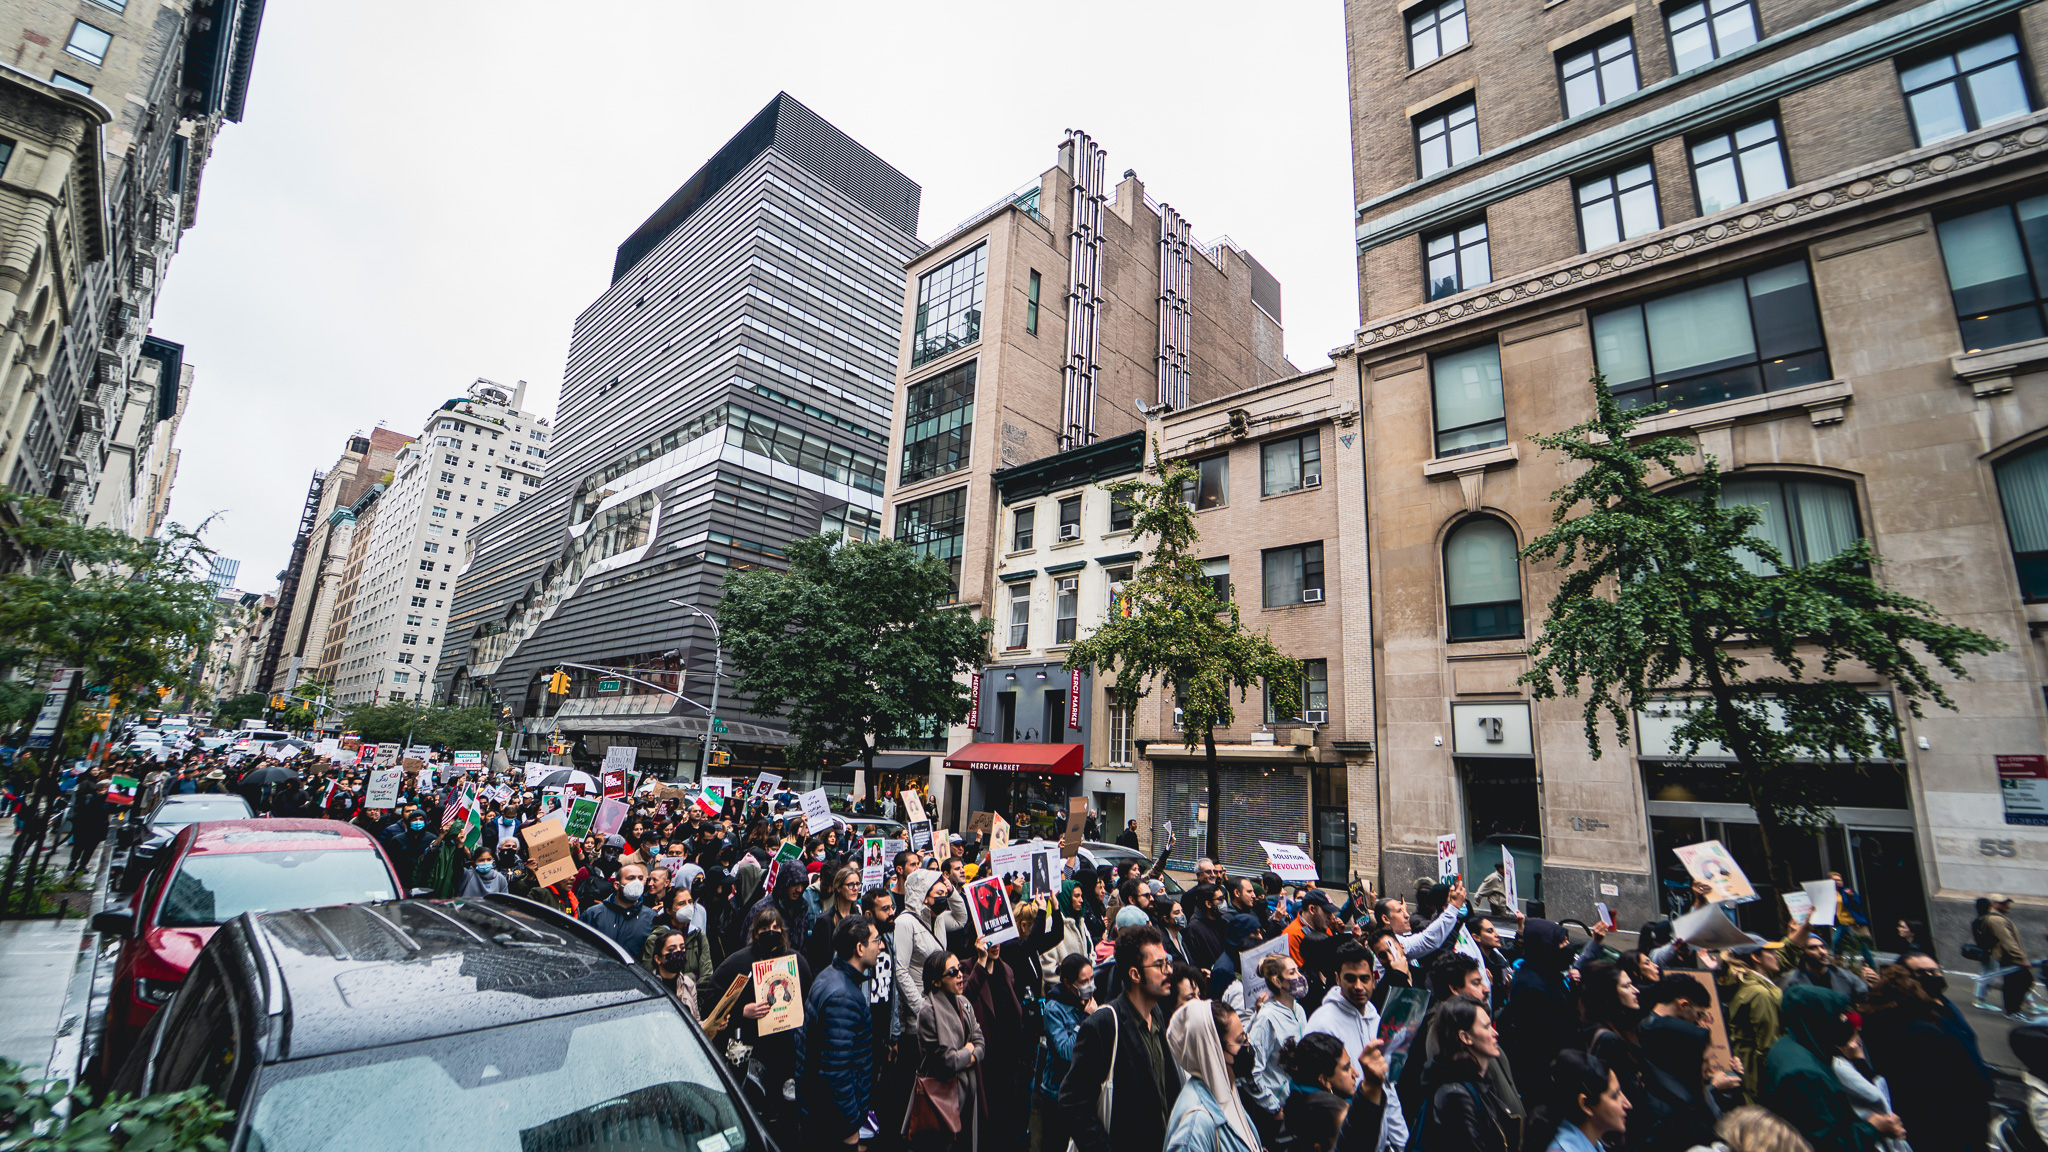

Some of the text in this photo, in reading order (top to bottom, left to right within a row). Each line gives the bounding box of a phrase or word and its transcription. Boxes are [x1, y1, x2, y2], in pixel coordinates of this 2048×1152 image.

[1071, 695, 1079, 727] MARKET
[970, 762, 1020, 771] MERCI MARKET
[1979, 838, 2017, 857] 55
[541, 867, 562, 880] IRAN
[1271, 863, 1315, 871] REVOLUTION
[1444, 859, 1452, 874] IS
[984, 920, 991, 931] BE
[989, 917, 1001, 929] THEIR
[999, 914, 1010, 925] VOICE
[772, 1005, 788, 1013] WOMAN
